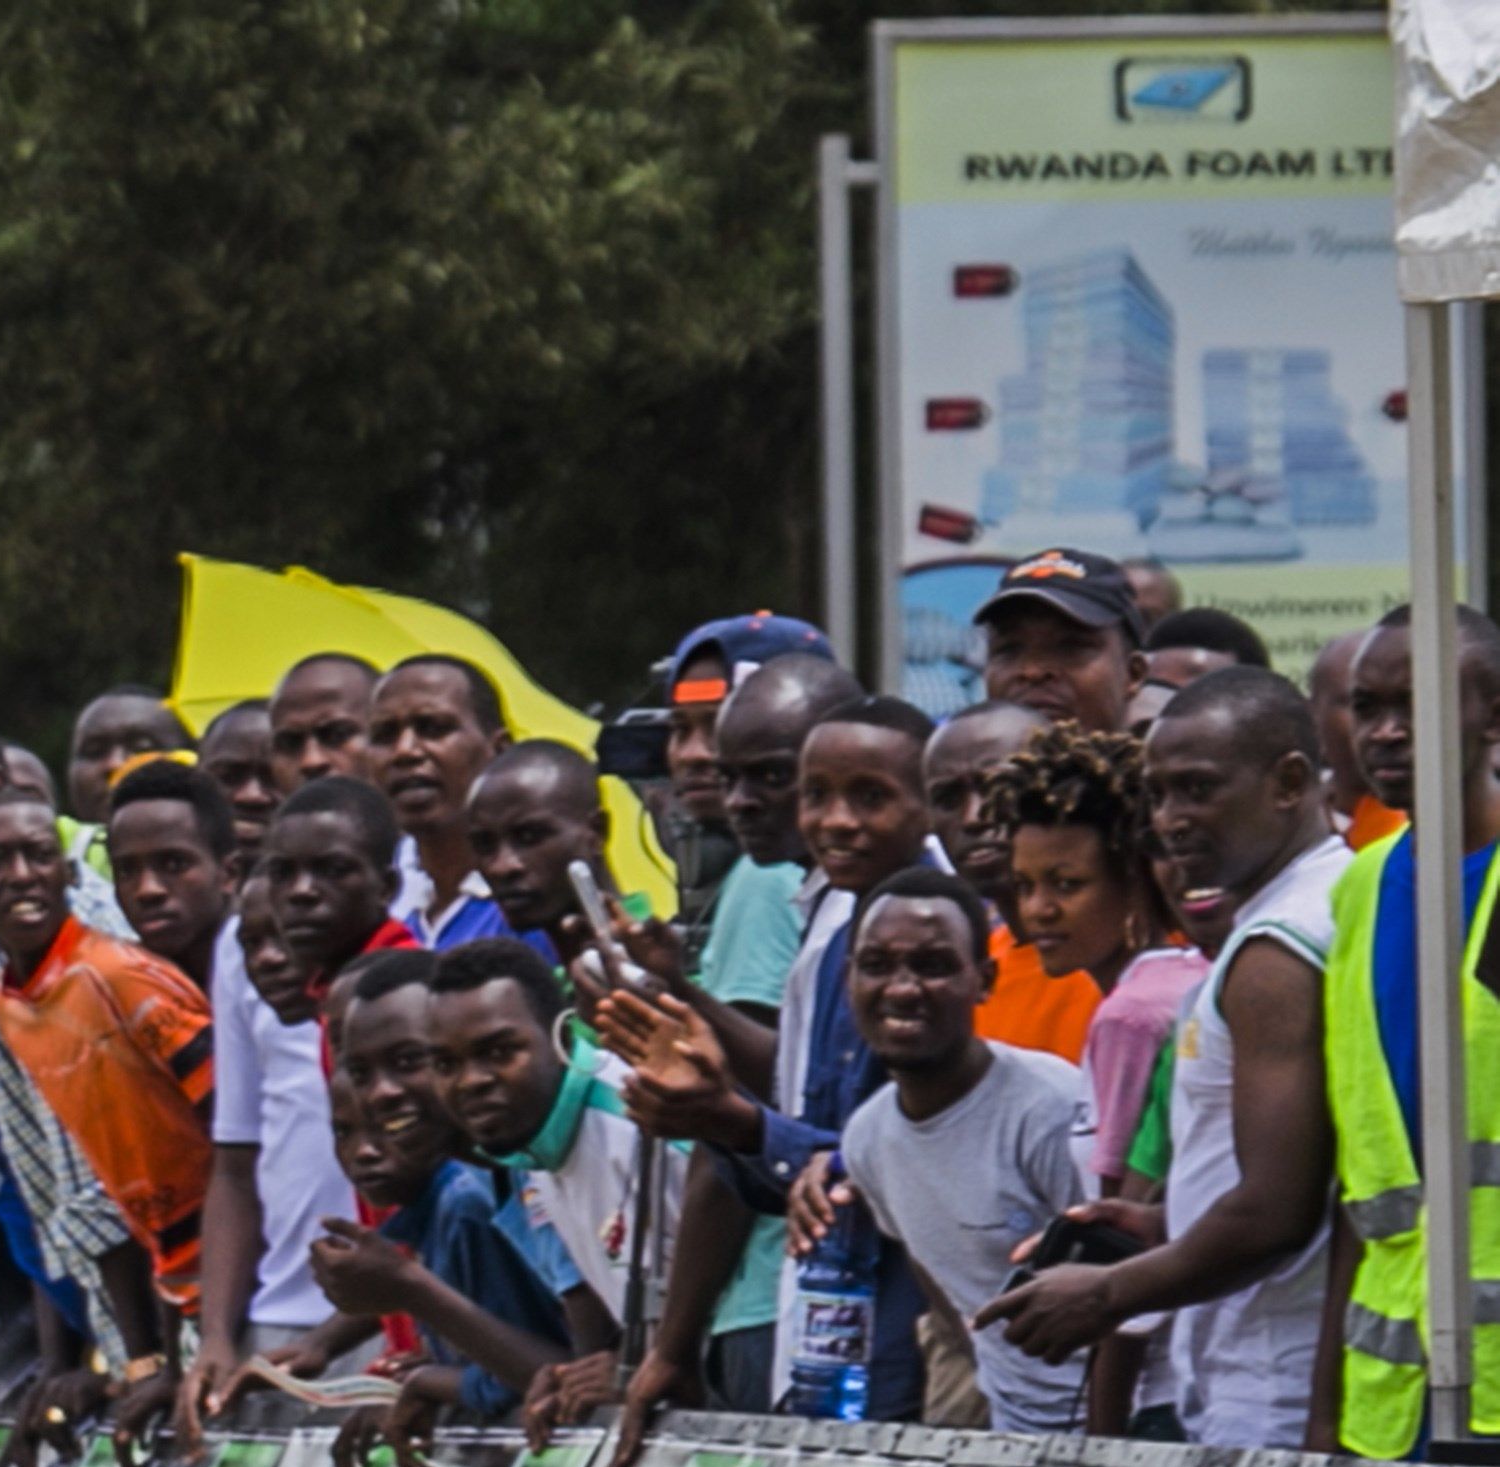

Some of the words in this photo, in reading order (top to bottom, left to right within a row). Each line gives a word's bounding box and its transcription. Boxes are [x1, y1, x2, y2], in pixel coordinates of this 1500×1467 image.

[965, 150, 1171, 182] RWANDA
[1186, 147, 1317, 180] FOAM
[1332, 145, 1394, 178] LT
